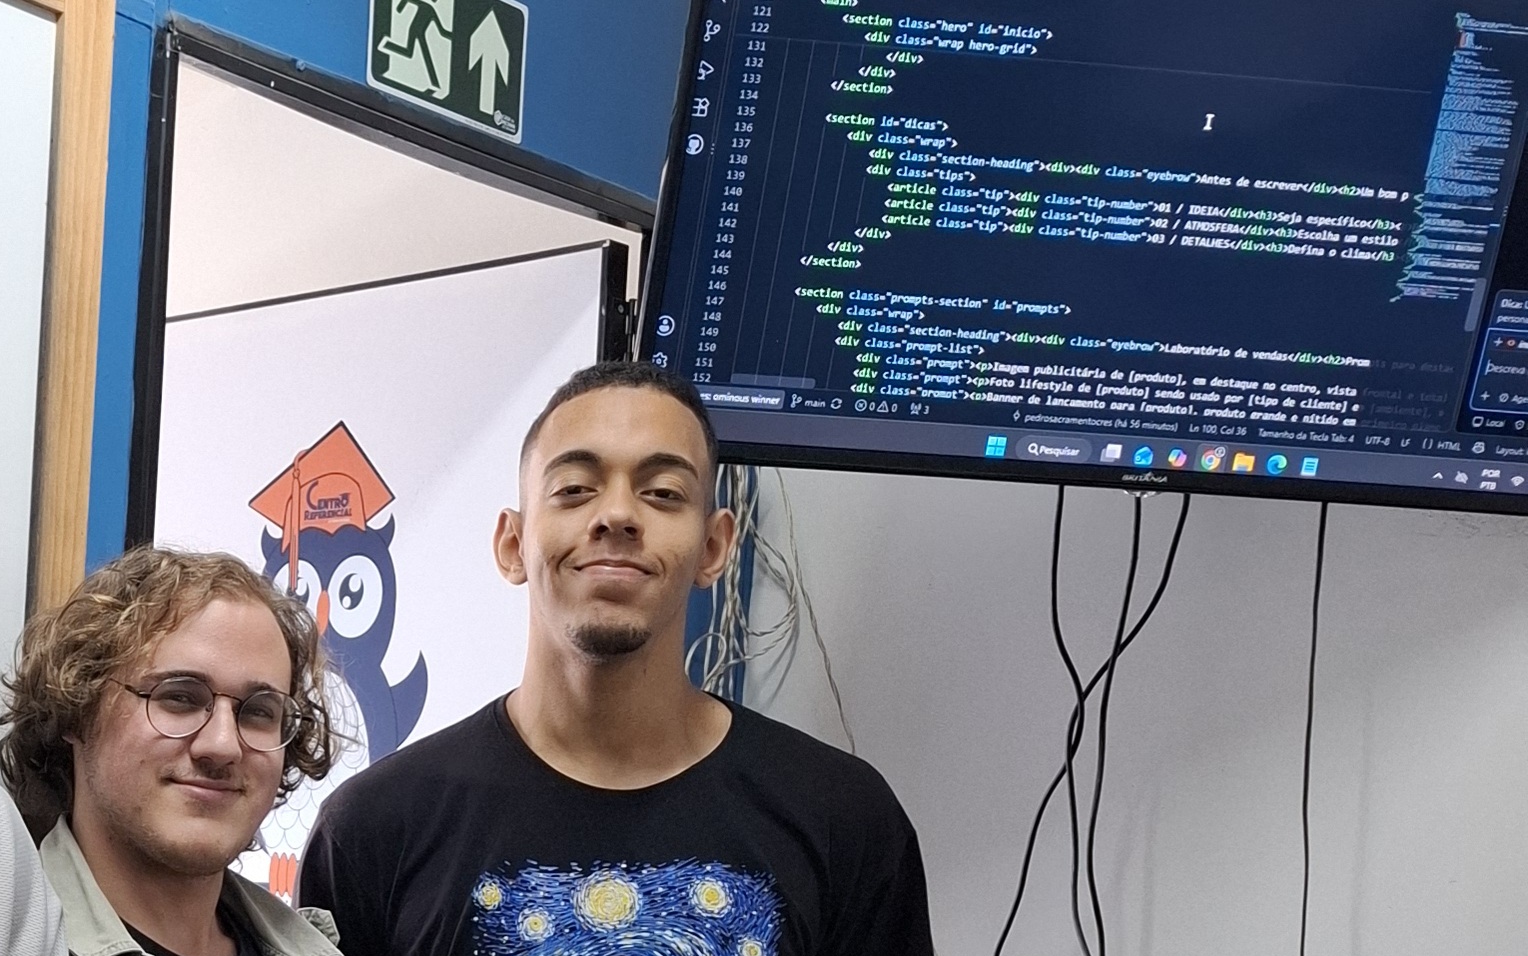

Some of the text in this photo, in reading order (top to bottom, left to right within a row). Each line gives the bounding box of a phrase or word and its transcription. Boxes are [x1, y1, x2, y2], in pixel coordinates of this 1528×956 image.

[752, 5, 772, 17] 121
[841, 13, 893, 28] <section
[897, 16, 974, 33] class="hero"
[750, 21, 770, 34] 122
[863, 30, 891, 44] <div
[747, 40, 925, 65] 131 </div>
[744, 56, 897, 79] 132 </div>
[739, 89, 759, 100] 134
[741, 72, 894, 95] 133 </section>
[736, 105, 949, 132] 135 <section id="dicas">
[734, 121, 754, 133] 136
[846, 129, 874, 142] <div
[728, 153, 977, 183] 138 <div class="tips">
[731, 137, 752, 149] 137
[868, 147, 895, 160] <div
[1235, 175, 1251, 188] de
[726, 169, 746, 181] 139
[886, 182, 938, 196] <article
[723, 185, 743, 197] 140
[883, 198, 935, 211] <article
[720, 201, 740, 213] 141
[881, 213, 932, 227] <article
[718, 217, 892, 240] 142 </div>
[715, 233, 865, 254] 143 </div>
[710, 264, 730, 276] 145
[712, 249, 862, 269] 144 </section>
[707, 279, 727, 291] 146
[794, 286, 844, 300] <section
[705, 295, 725, 306] 147
[815, 302, 842, 315] <div
[699, 326, 719, 337] 149
[834, 334, 861, 347] <div
[702, 311, 722, 322] 148
[837, 319, 864, 332] <div
[1233, 347, 1249, 359] de
[697, 341, 717, 353] 150
[855, 352, 881, 364] <div
[1109, 368, 1125, 381] de
[1209, 376, 1260, 392] destaque
[1261, 381, 1277, 391] no
[1279, 383, 1322, 396] centro,
[1326, 384, 1358, 397] vista
[692, 372, 712, 383] 152
[849, 382, 876, 394] <div
[1027, 393, 1042, 406] de
[694, 357, 713, 368] 151
[852, 367, 879, 379] <div
[1018, 377, 1074, 394] lifestyle
[1077, 381, 1092, 394] de
[1153, 388, 1186, 400] sendo
[1188, 391, 1221, 403] usado
[1222, 394, 1245, 405] por
[1281, 396, 1297, 408] de
[804, 398, 826, 408] main
[922, 405, 930, 415] 3
[1188, 423, 1200, 433] Ln
[1219, 425, 1236, 436] Col
[1235, 426, 1248, 436] 36
[1258, 427, 1295, 440] Tamanho
[1309, 431, 1330, 442] Tecla
[1039, 446, 1080, 457] Pesquisar
